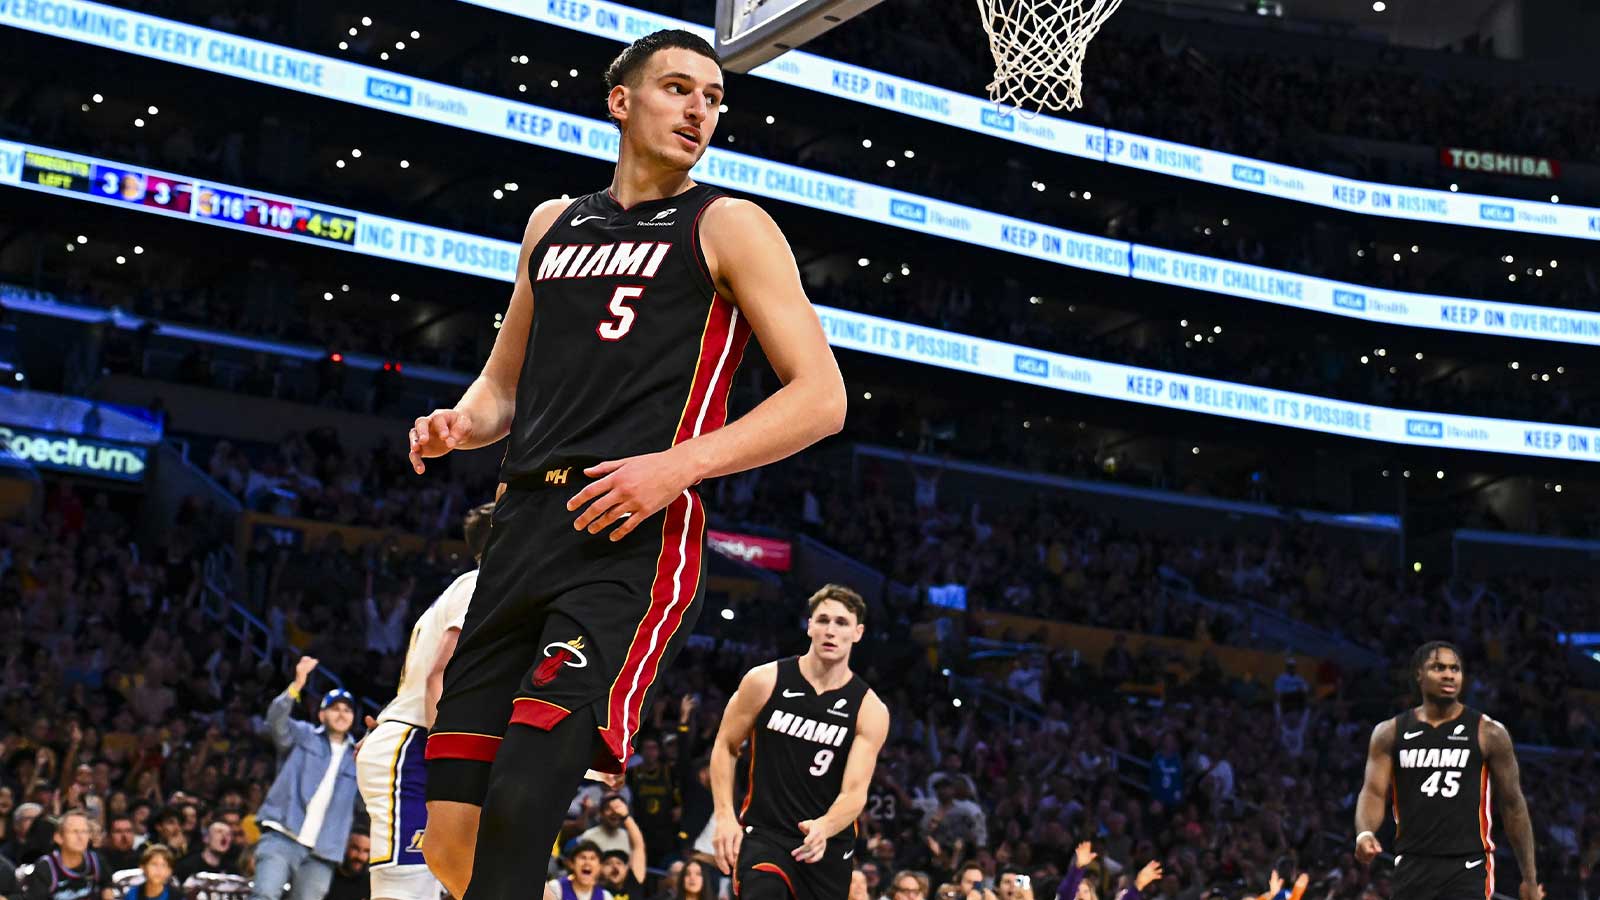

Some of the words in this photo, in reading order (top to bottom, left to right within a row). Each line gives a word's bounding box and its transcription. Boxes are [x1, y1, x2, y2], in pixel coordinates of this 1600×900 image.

[596, 8, 619, 30] ON
[134, 22, 201, 57] EVERY
[208, 40, 324, 86] CHALLENGE
[417, 92, 468, 116] Health
[832, 69, 871, 95] KEEP
[876, 80, 896, 101] ON
[901, 86, 950, 116] RISING
[506, 109, 552, 138] KEEP
[557, 121, 583, 145] ON
[1085, 133, 1125, 157] KEEP
[1130, 140, 1149, 161] ON
[1154, 144, 1203, 174] RISING
[1449, 149, 1552, 178] TOSHIBA
[102, 172, 119, 194] 3
[154, 182, 171, 205] 3
[708, 155, 761, 188] EVERY
[765, 169, 857, 209] CHALLENGE
[210, 194, 245, 221] 116
[1332, 184, 1366, 206] KEEP
[1372, 191, 1392, 209] ON
[1397, 194, 1448, 216] RISING
[258, 202, 293, 230] 110
[306, 214, 355, 241] 4:57
[401, 230, 436, 257] IT'S
[536, 241, 673, 281] MIAMI
[1001, 224, 1037, 250] KEEP
[1042, 233, 1061, 254] ON
[1172, 259, 1218, 285] EVERY
[1222, 268, 1303, 300] CHALLENGE
[596, 284, 646, 342] 5
[1441, 305, 1478, 324] KEEP
[1484, 309, 1505, 327] ON
[871, 326, 900, 350] IT'S
[906, 332, 979, 366] POSSIBLE
[1126, 373, 1163, 397] KEEP
[1169, 381, 1188, 401] ON
[1194, 385, 1268, 415] BELIEVING
[1274, 398, 1299, 418] IT'S
[1304, 402, 1372, 431] POSSIBLE
[1523, 430, 1562, 450] KEEP
[1568, 434, 1588, 453] ON
[767, 709, 848, 747] MIAMI
[809, 749, 834, 778] 9
[1400, 748, 1470, 769] MIAMI
[1420, 770, 1462, 798] 45
[869, 794, 896, 820] 23
